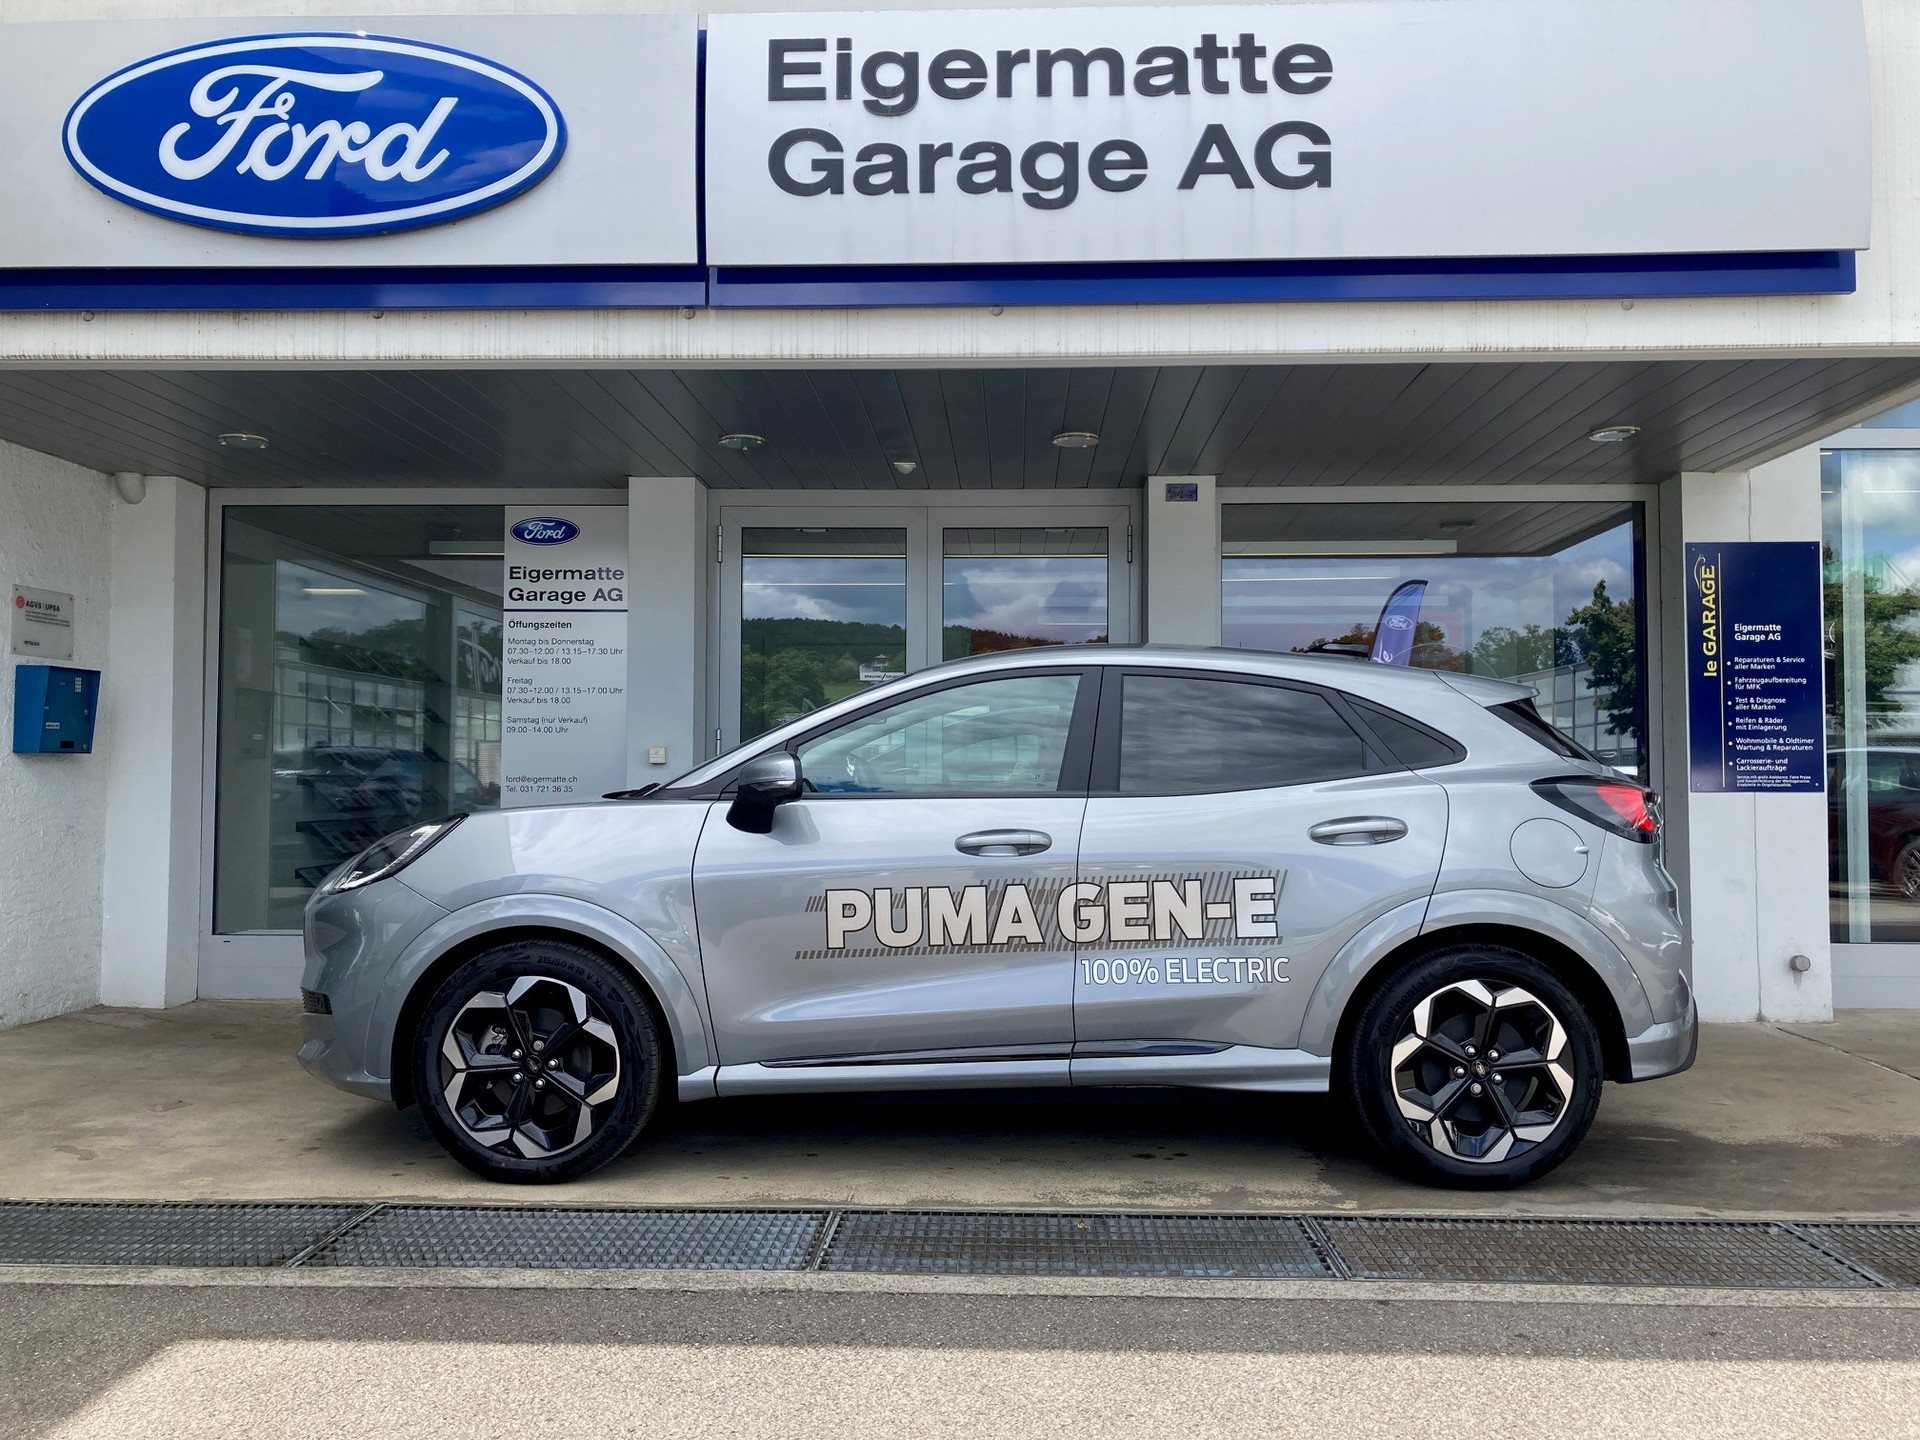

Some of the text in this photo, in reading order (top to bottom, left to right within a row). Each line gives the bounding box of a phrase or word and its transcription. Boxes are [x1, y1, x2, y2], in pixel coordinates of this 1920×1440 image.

[767, 32, 1334, 117] Eigermatte
[158, 64, 459, 183] Ford
[767, 120, 1332, 211] Garage AG
[524, 520, 565, 540] Ford
[508, 565, 625, 583] Eigermatte
[508, 587, 624, 605] Garage AG
[25, 600, 61, 612] AGVS UPSA
[508, 619, 572, 632] Öffungszeiten
[1389, 617, 1408, 629] Ford
[1702, 565, 1718, 677] le GARAGE
[1734, 623, 1782, 633] Eigermatte
[1734, 632, 1781, 642] Garage AG
[507, 638, 595, 647] Montag bis Donnerstag
[609, 647, 624, 656] Uhr
[507, 656, 572, 666] Verkauf bis 18.00
[1734, 656, 1805, 665] Reparaturen & Service
[1734, 663, 1776, 671] aller Marken
[507, 676, 533, 687] Freitag
[1734, 676, 1807, 686] Fahrzeugaufbereitung
[1734, 682, 1762, 690] für MFK
[609, 687, 624, 695] Uhr
[507, 696, 571, 705] Verkauf bis 18.00
[1755, 697, 1787, 705] Diagnose
[1735, 703, 1777, 711] aller Marken
[506, 715, 589, 726] Samstag (nur Verkauf)
[554, 726, 569, 735] Uhr
[1735, 723, 1787, 732] mit Einlagerung
[1736, 737, 1815, 745] Wohnmobile & Oldtimer
[1736, 744, 1814, 753] Wartung & Reparaturen
[1736, 757, 1789, 765] Carrosserie- und
[1736, 764, 1787, 773] Lackieraufträge
[505, 775, 578, 785] ford@eigermatte.ch
[505, 784, 574, 794] Tel. 031 721 36 35
[824, 875, 1280, 951] PUMA GEN-E
[1080, 955, 1292, 986] 100% ELECTRIC
